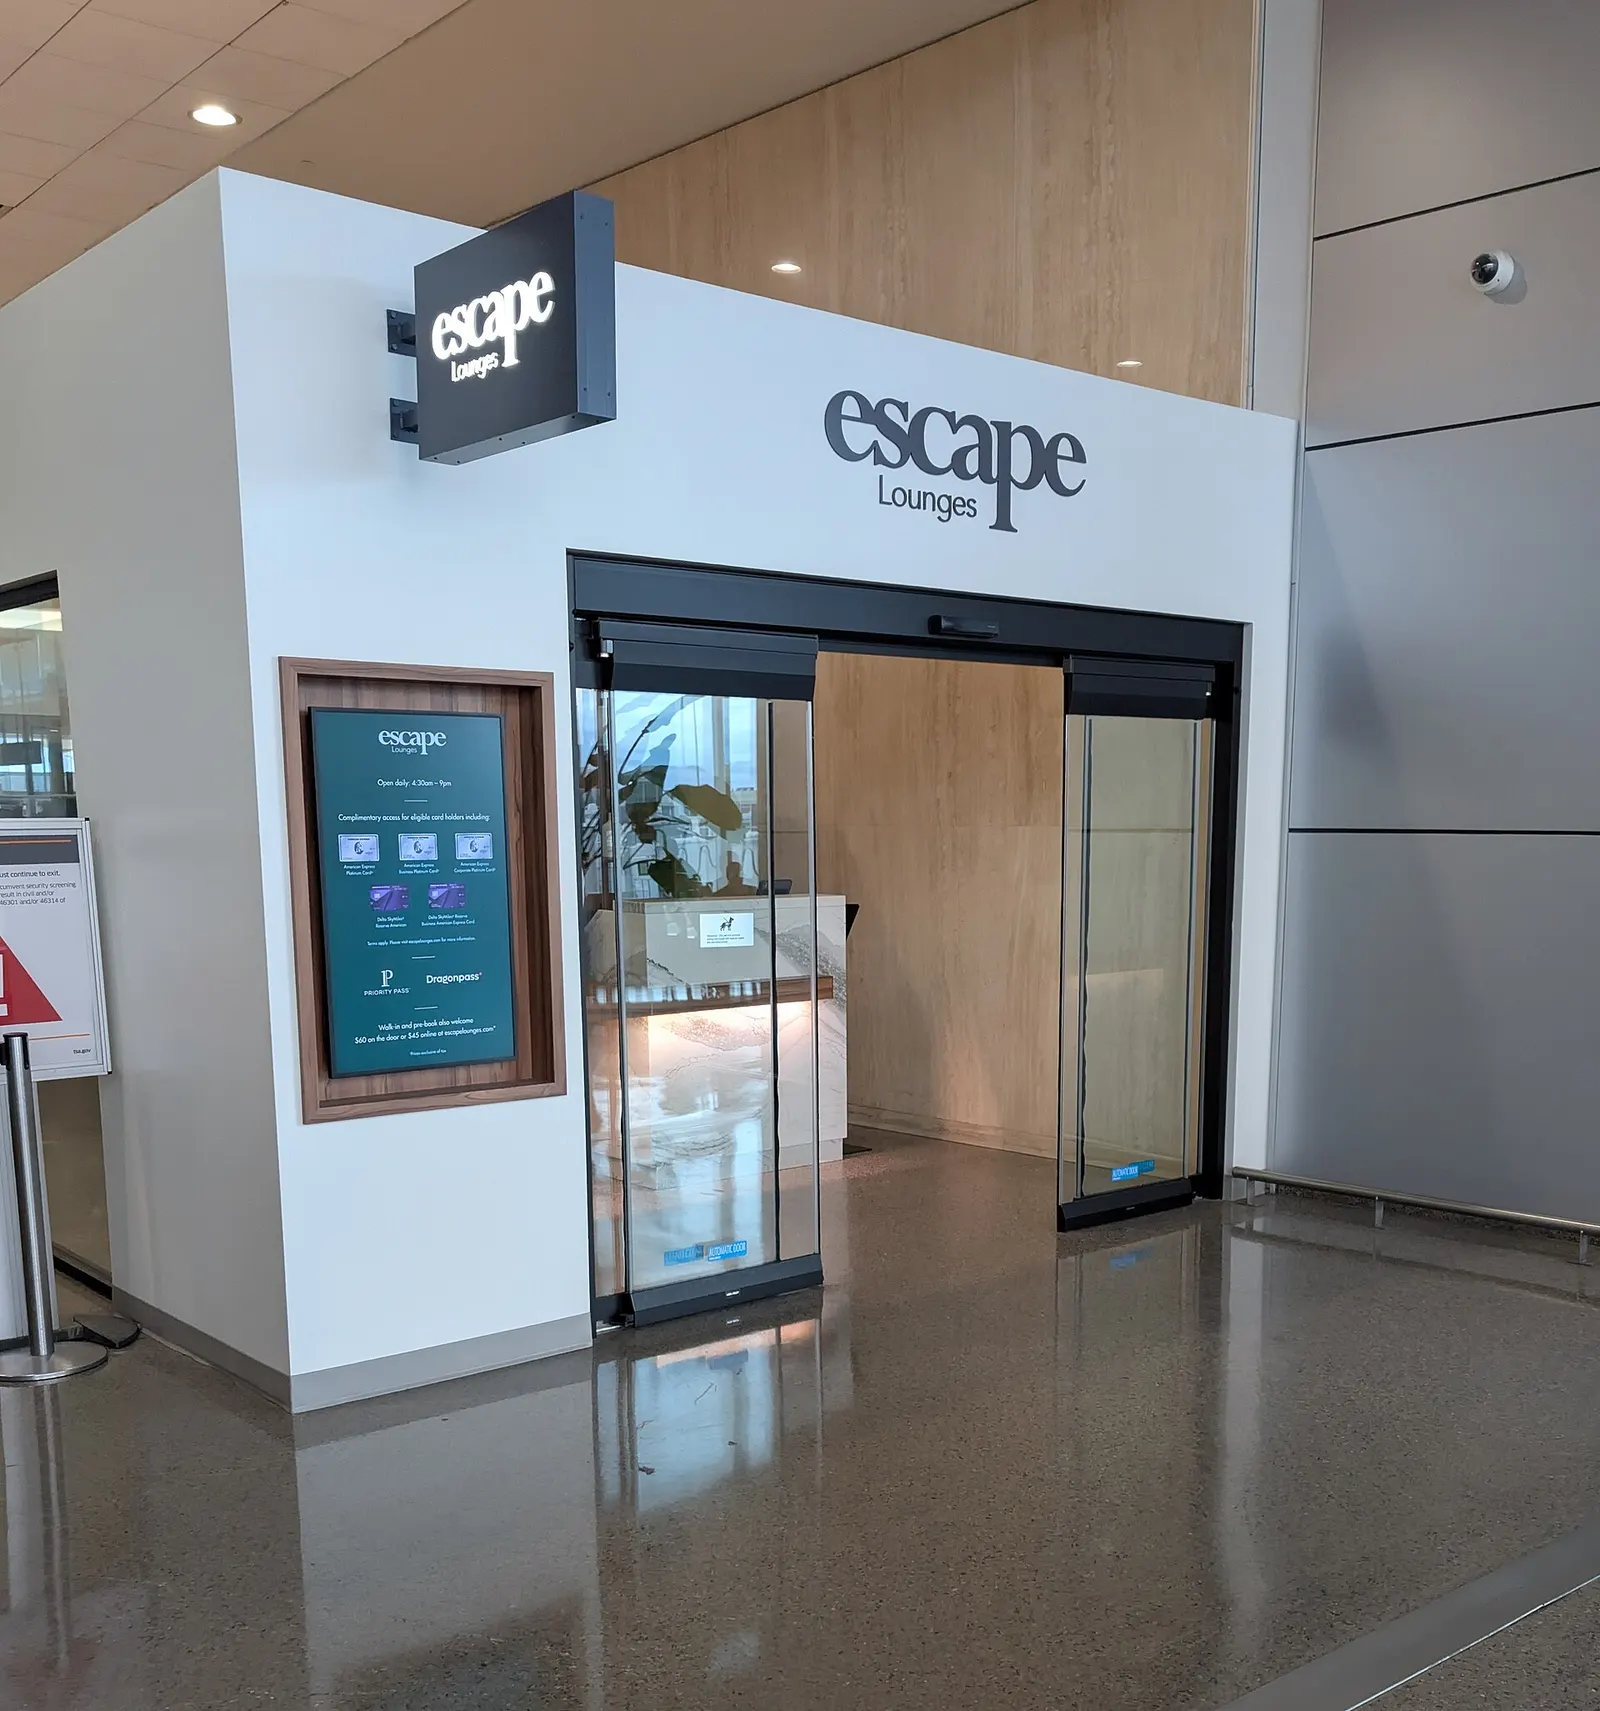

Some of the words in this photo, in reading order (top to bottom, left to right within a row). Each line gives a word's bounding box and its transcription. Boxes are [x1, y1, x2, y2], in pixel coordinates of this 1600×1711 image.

[432, 271, 555, 367] escape
[451, 352, 498, 382] Lounges
[824, 390, 1087, 533] escape
[879, 474, 977, 523] Lounges
[378, 730, 447, 755] escape
[391, 746, 417, 755] Lounges
[377, 779, 394, 788] Open
[439, 780, 452, 788] 9pm
[338, 814, 381, 822] Complimentary
[410, 813, 430, 822] eligible
[465, 813, 490, 822] including:
[364, 988, 392, 996] PRIORITY
[378, 1022, 400, 1031] Walk-in
[402, 1021, 412, 1029] and
[414, 1020, 438, 1032] pre-book
[438, 1018, 450, 1026] also
[450, 1016, 474, 1025] welcome
[354, 1036, 366, 1045] $60
[386, 1033, 399, 1041] door
[408, 1032, 419, 1040] $45
[420, 1030, 437, 1038] online
[709, 1244, 733, 1256] AUTOMATIC
[733, 1242, 746, 1252] DOOR
